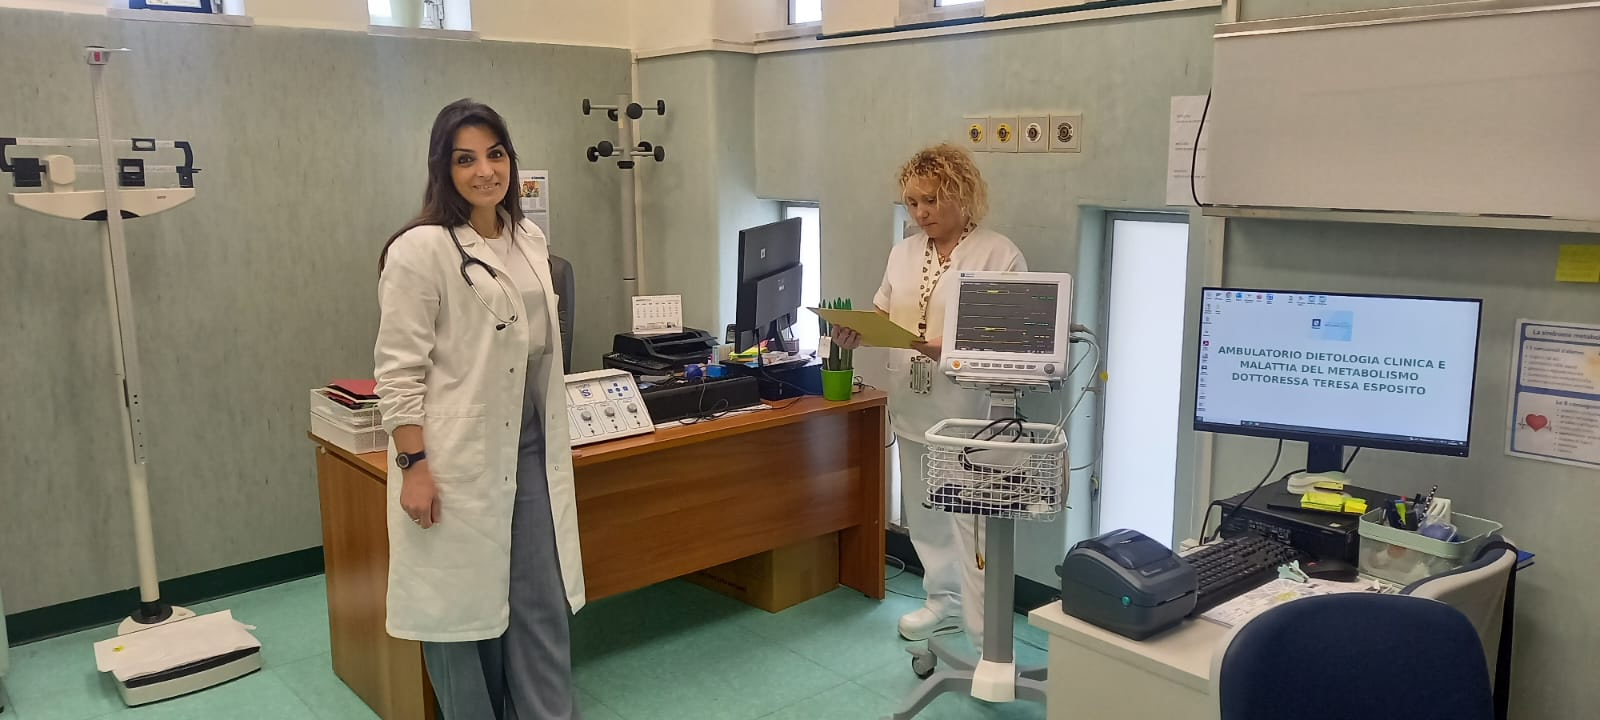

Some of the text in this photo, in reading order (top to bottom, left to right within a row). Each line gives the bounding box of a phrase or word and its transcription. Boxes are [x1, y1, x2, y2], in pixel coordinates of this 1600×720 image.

[1218, 345, 1447, 370] AMBULATORIO DIETOLOGIA CLINICA E
[1240, 360, 1419, 381] MALATTIA DEL METABOLISMO
[1231, 372, 1426, 396] DOTTORESSA TERESA ESPOSITO
